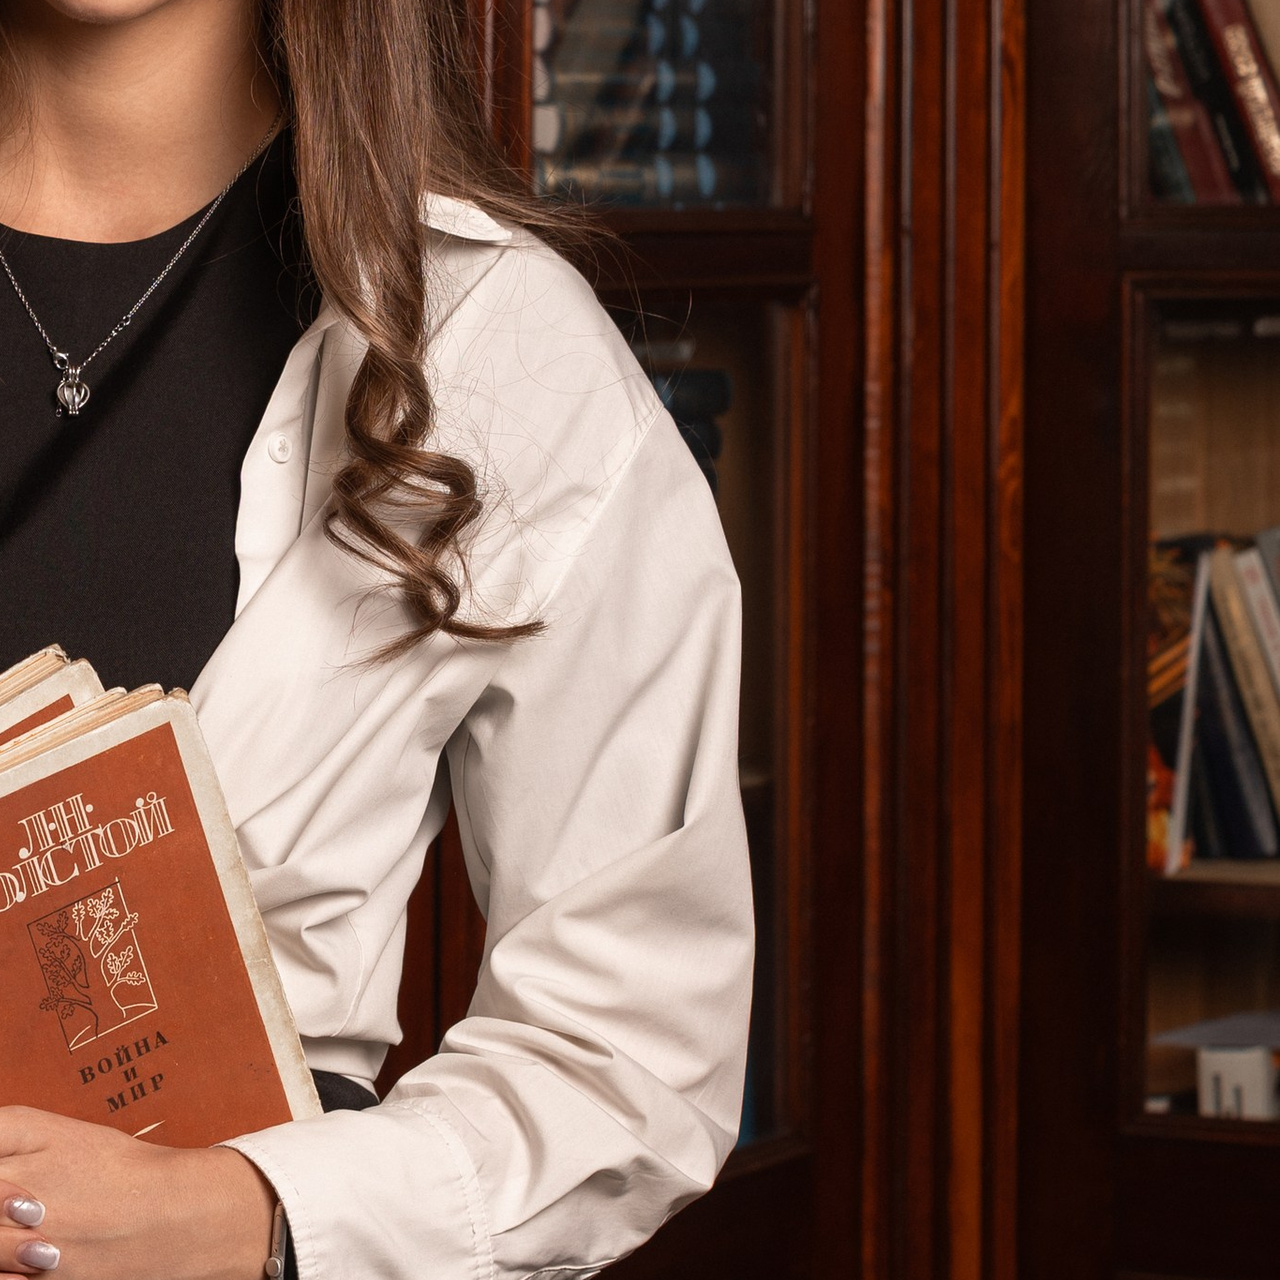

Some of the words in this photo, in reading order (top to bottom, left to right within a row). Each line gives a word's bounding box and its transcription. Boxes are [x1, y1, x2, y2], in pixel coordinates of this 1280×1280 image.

[78, 1030, 169, 1085] ВОЙНА
[122, 1066, 139, 1083] И
[106, 1073, 165, 1114] МИР
